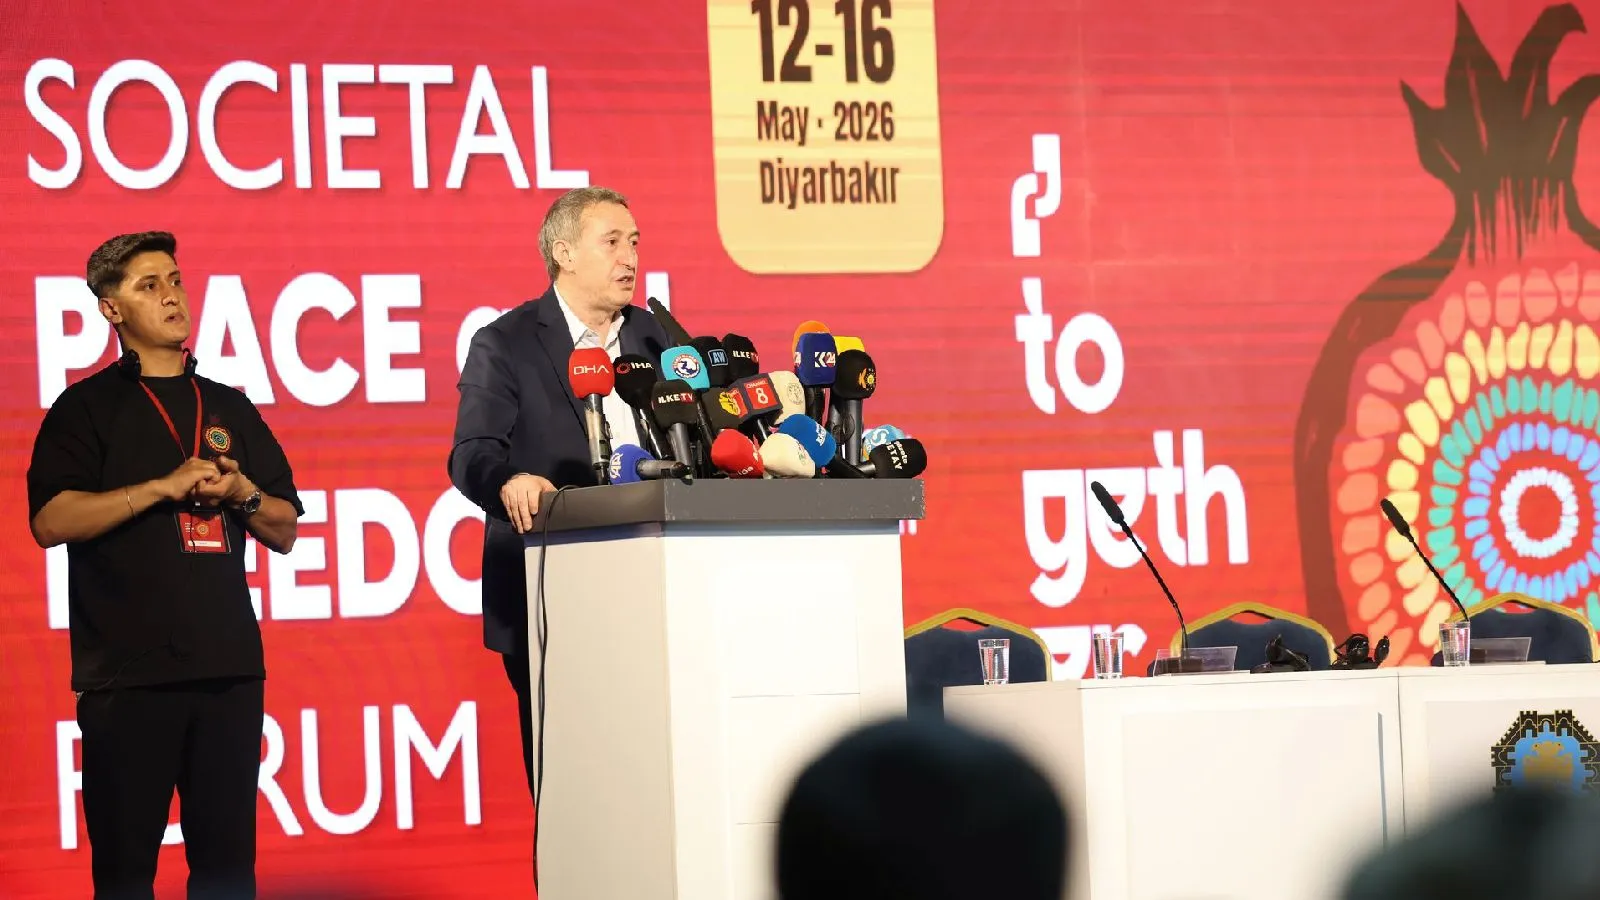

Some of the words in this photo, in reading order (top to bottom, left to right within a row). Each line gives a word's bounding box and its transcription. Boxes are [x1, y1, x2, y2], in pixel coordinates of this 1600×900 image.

[751, 0, 895, 83] 12-16
[25, 58, 590, 190] SOCIETAL
[757, 100, 809, 146] May
[834, 101, 895, 141] 2026
[760, 157, 900, 210] Diyarbakır
[35, 272, 426, 409] PACE
[573, 365, 610, 376] DHA
[814, 352, 836, 368] K24
[1015, 277, 1125, 415] to
[756, 387, 769, 405] 8
[1022, 428, 1249, 608] geth
[56, 701, 482, 849] FRUM
